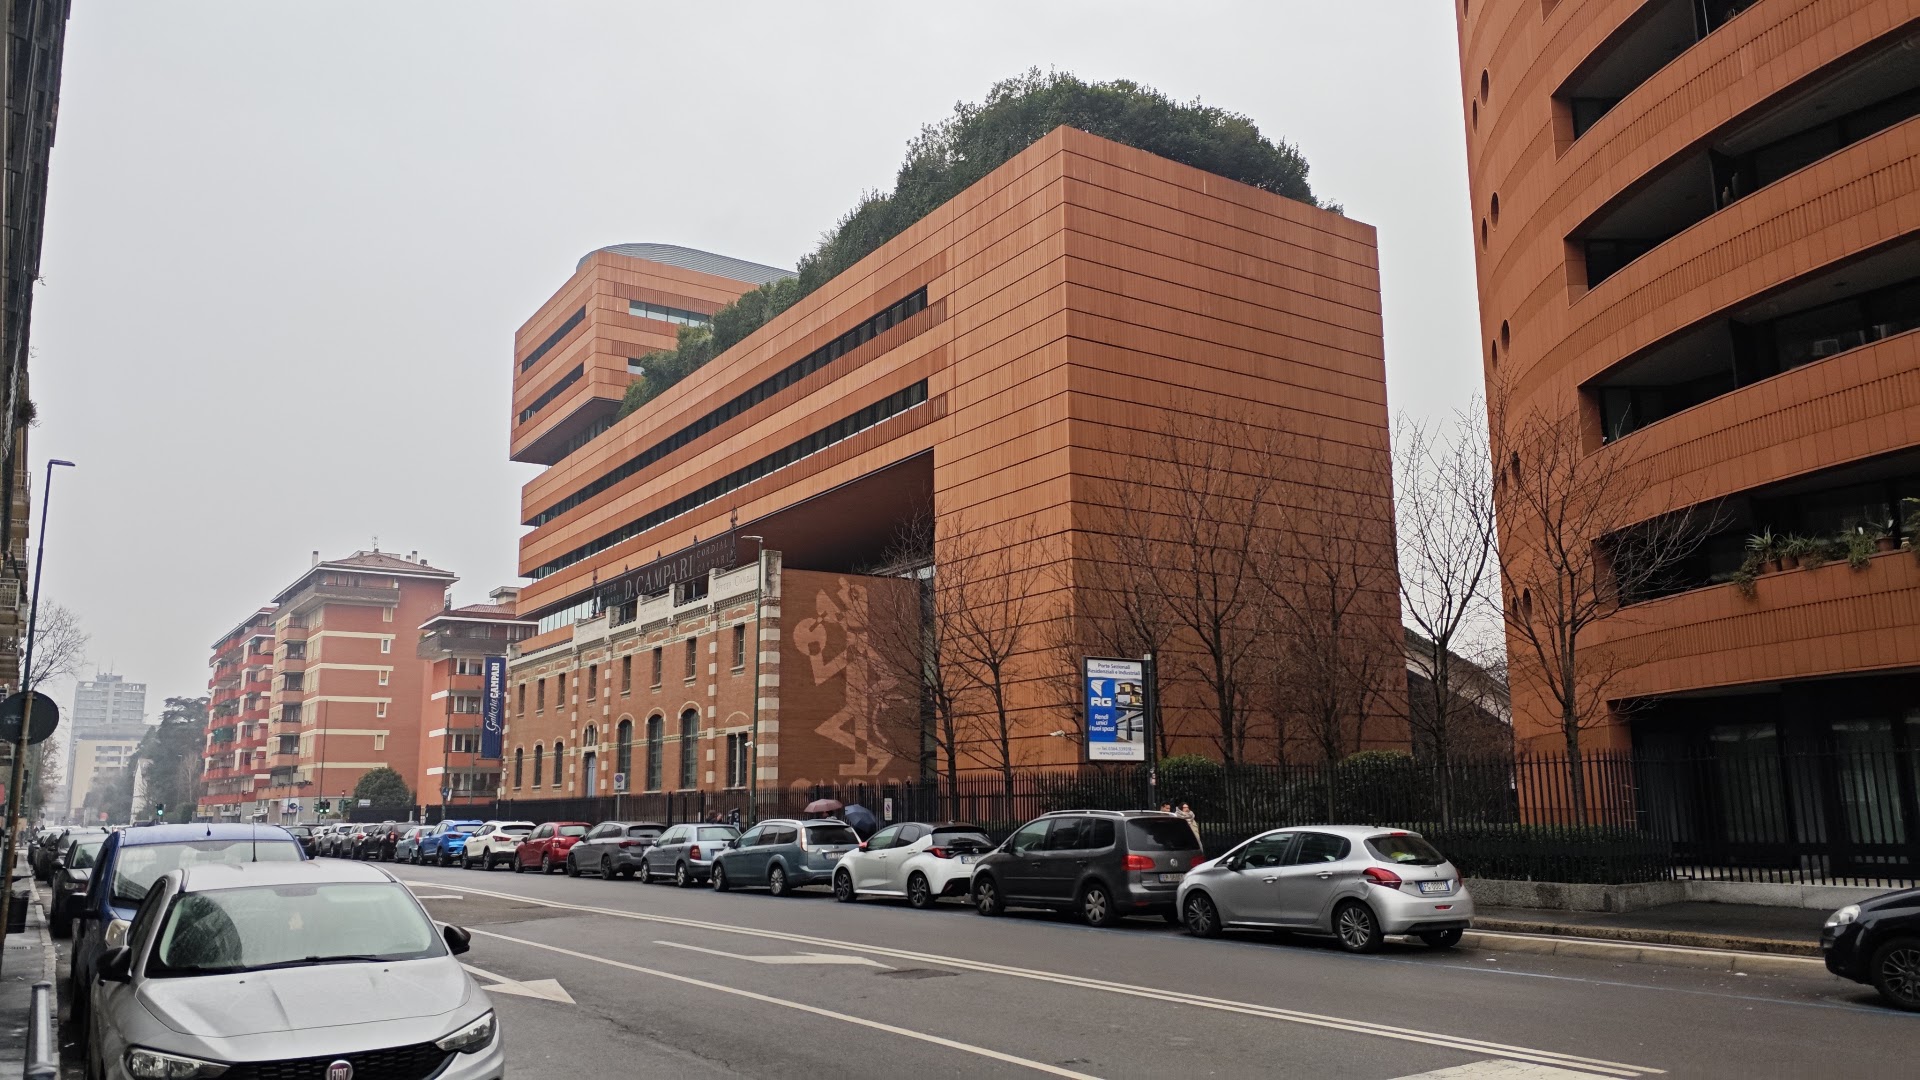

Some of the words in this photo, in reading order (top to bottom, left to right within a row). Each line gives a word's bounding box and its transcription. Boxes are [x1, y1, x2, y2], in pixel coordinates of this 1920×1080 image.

[696, 539, 728, 559] CORDIAL
[625, 579, 635, 600] D.
[636, 554, 693, 596] CAMPARI
[490, 662, 500, 698] CAMPARI
[1090, 697, 1112, 706] RG
[486, 698, 501, 734] Galleria
[331, 1068, 348, 1080] FIAT
